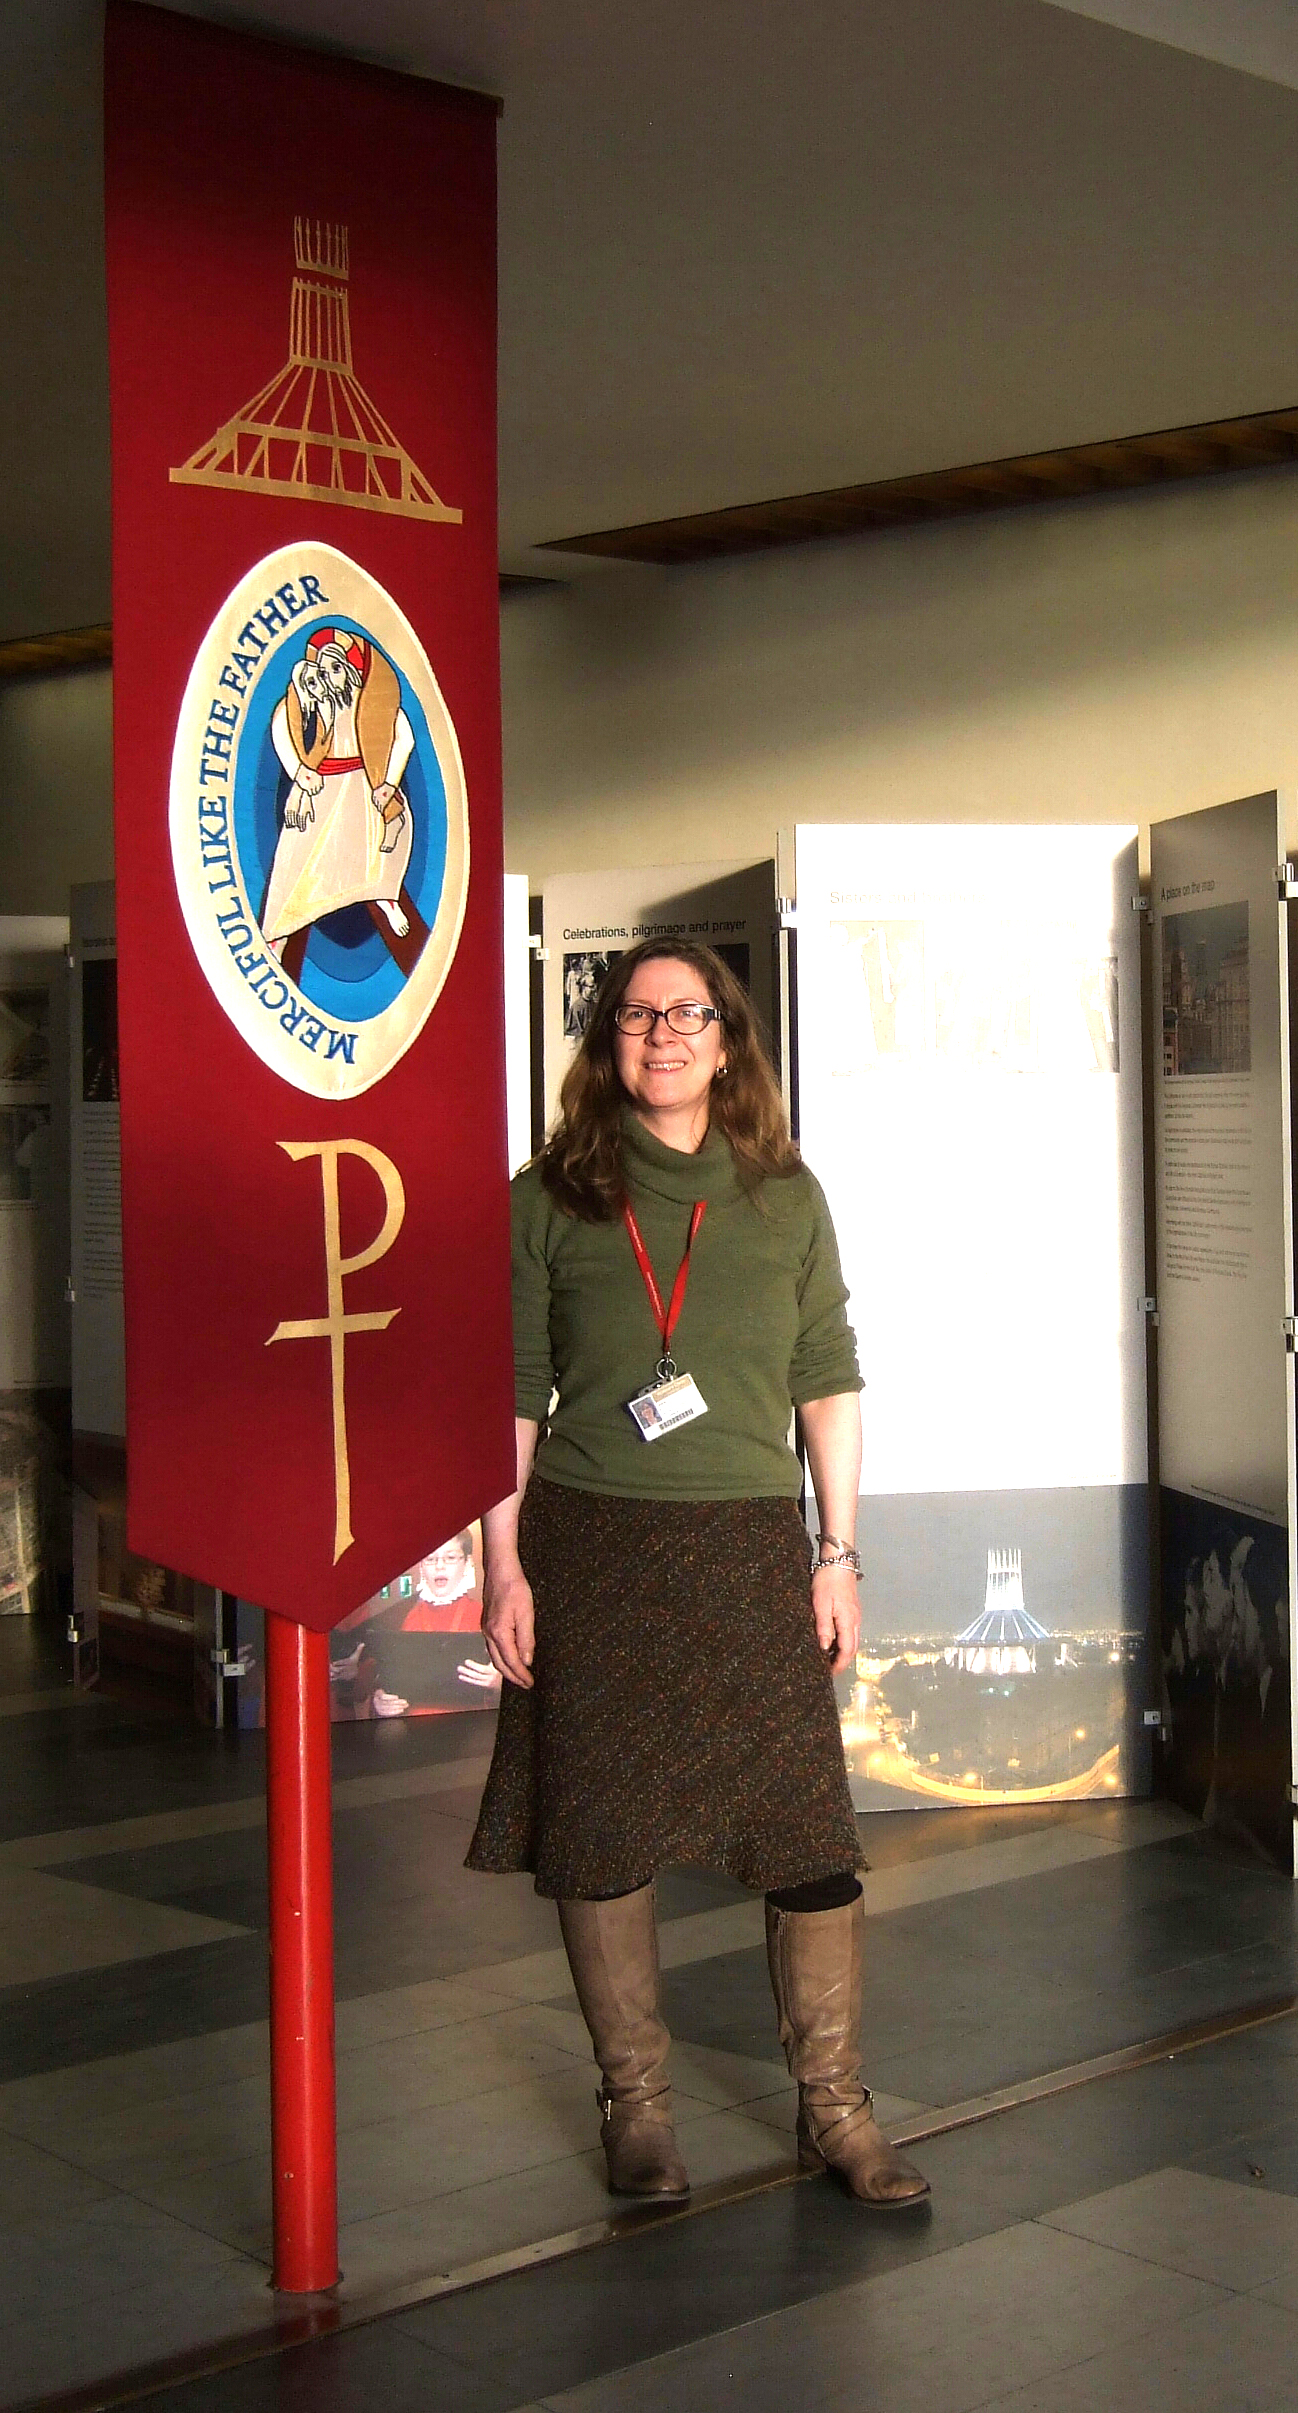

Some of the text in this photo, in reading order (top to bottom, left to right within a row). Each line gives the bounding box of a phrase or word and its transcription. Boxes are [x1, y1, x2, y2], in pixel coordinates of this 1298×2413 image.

[199, 575, 358, 1065] MERCIFUL LIKE THE FATHER
[563, 920, 747, 940] Celebrations, pilgrimage and prayer
